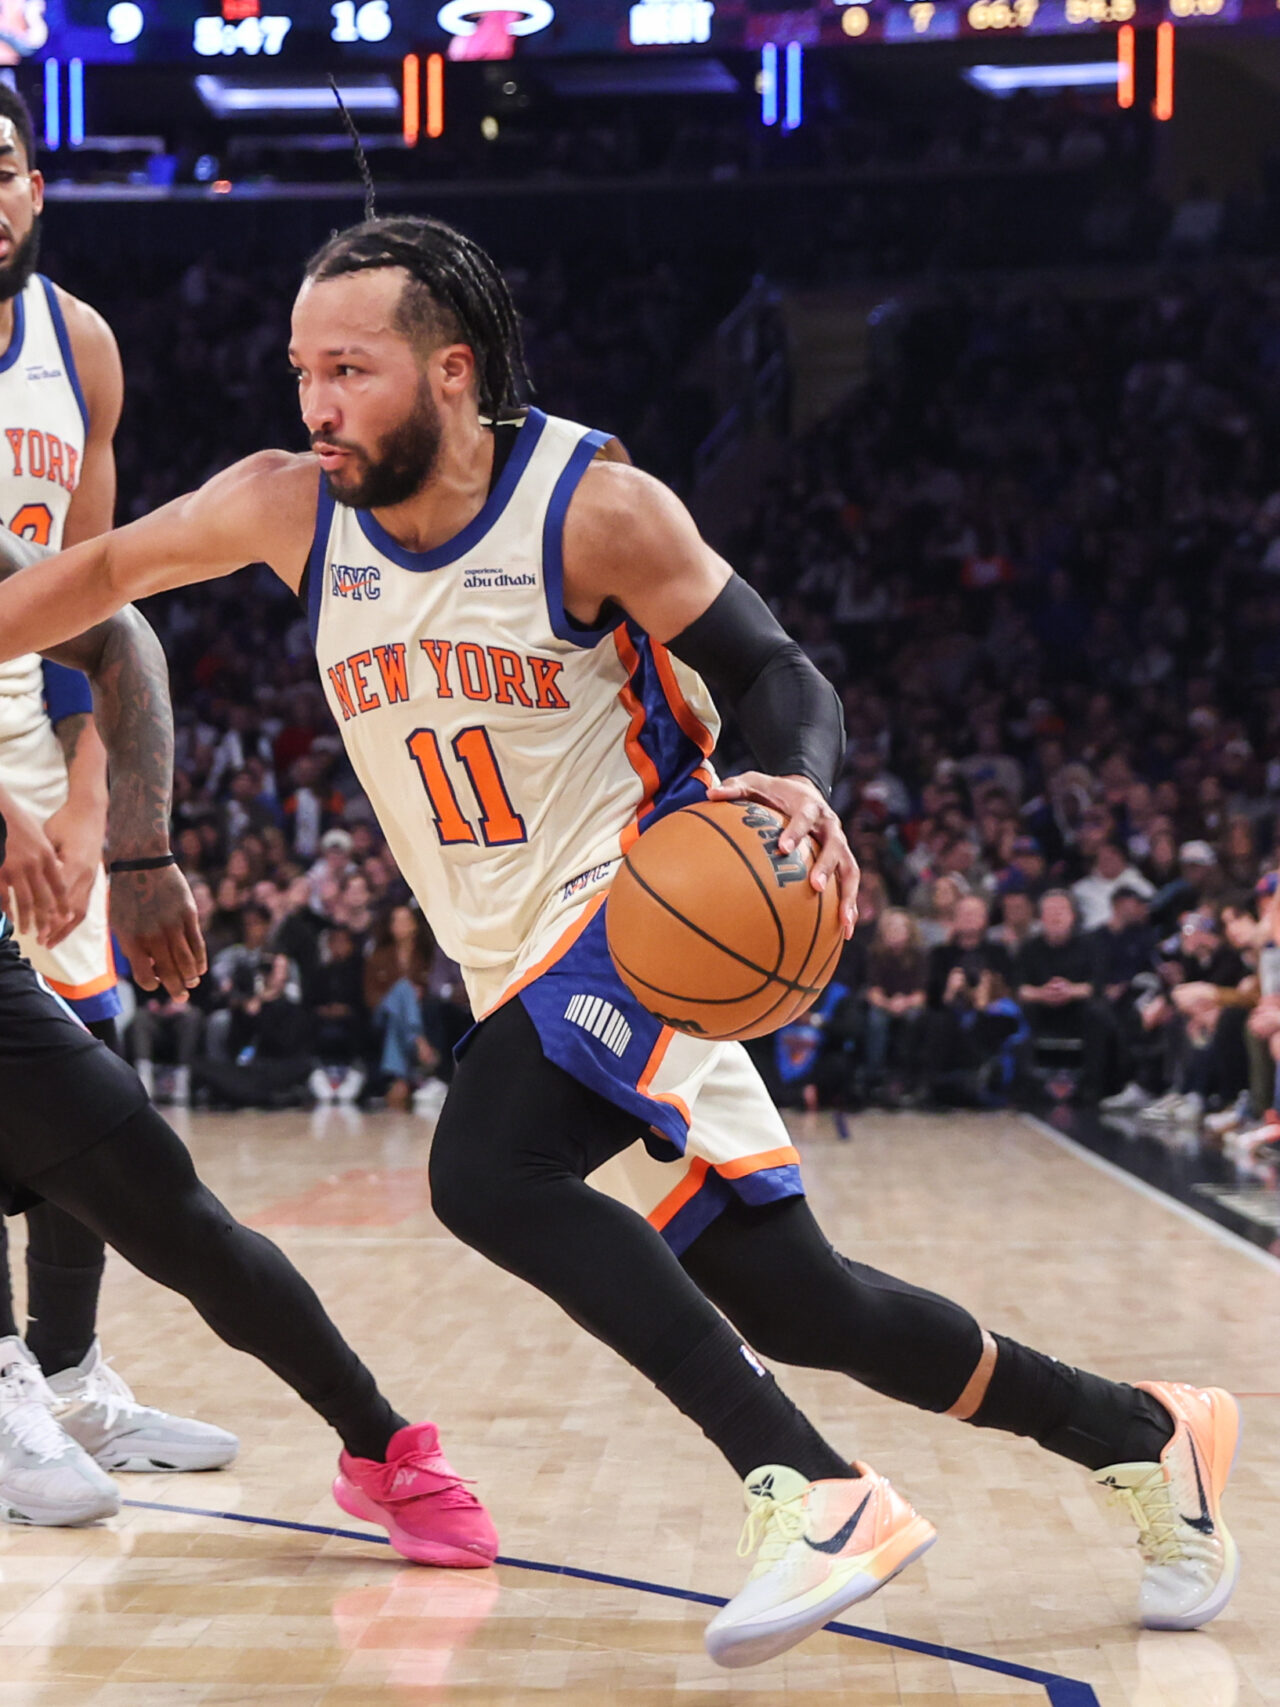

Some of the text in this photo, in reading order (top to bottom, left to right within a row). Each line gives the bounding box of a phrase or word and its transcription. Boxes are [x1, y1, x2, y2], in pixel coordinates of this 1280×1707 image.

[107, 2, 144, 44] 9
[330, 0, 392, 42] 16
[4, 427, 80, 492] YORK
[331, 564, 381, 600] NYC
[463, 573, 537, 588] abu dhabi
[328, 639, 570, 721] NEW YORK
[405, 725, 529, 847] 11
